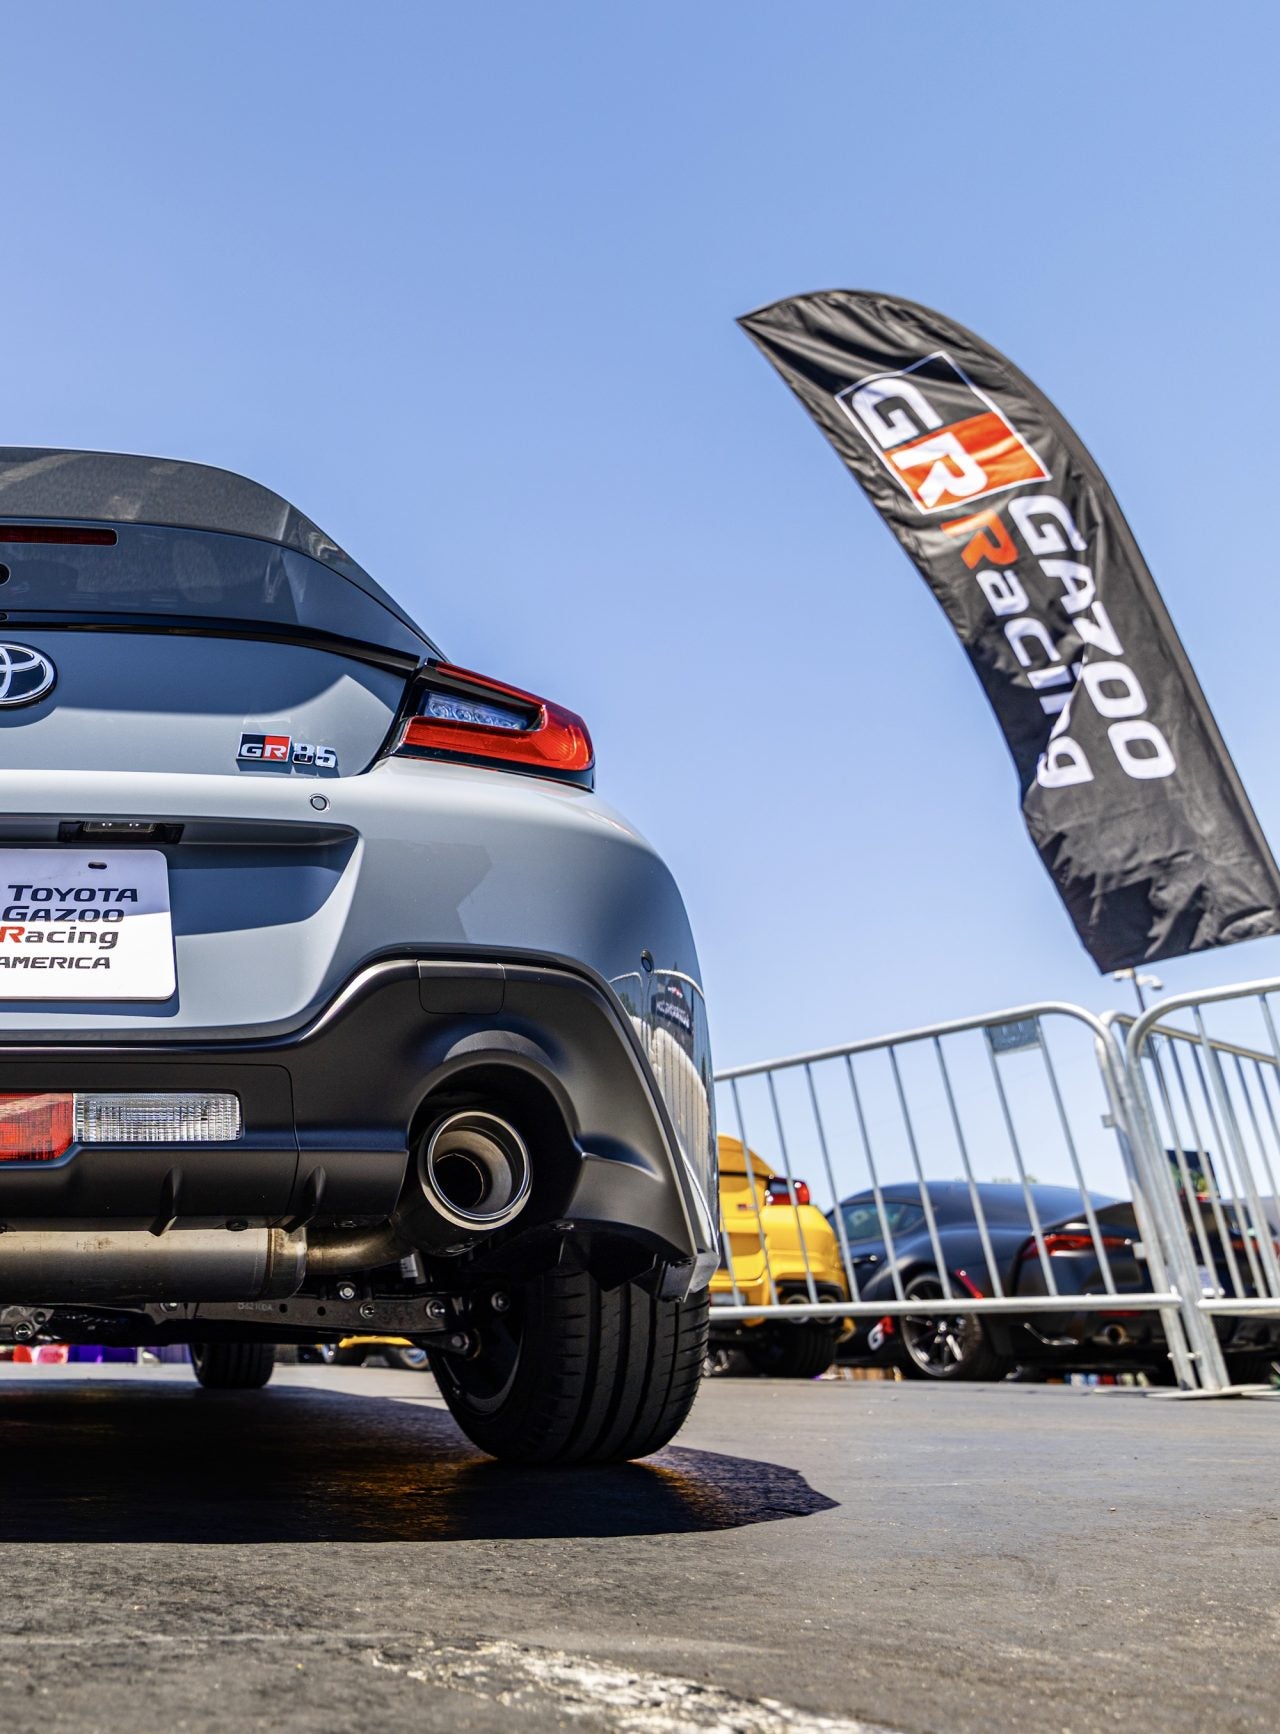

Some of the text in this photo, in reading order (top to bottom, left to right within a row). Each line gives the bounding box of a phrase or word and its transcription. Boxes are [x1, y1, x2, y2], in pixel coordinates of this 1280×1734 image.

[849, 375, 990, 510] GR
[1007, 494, 1177, 780] GAZOO
[1, 904, 125, 924] GAZOO
[8, 884, 139, 902] TOYOTA
